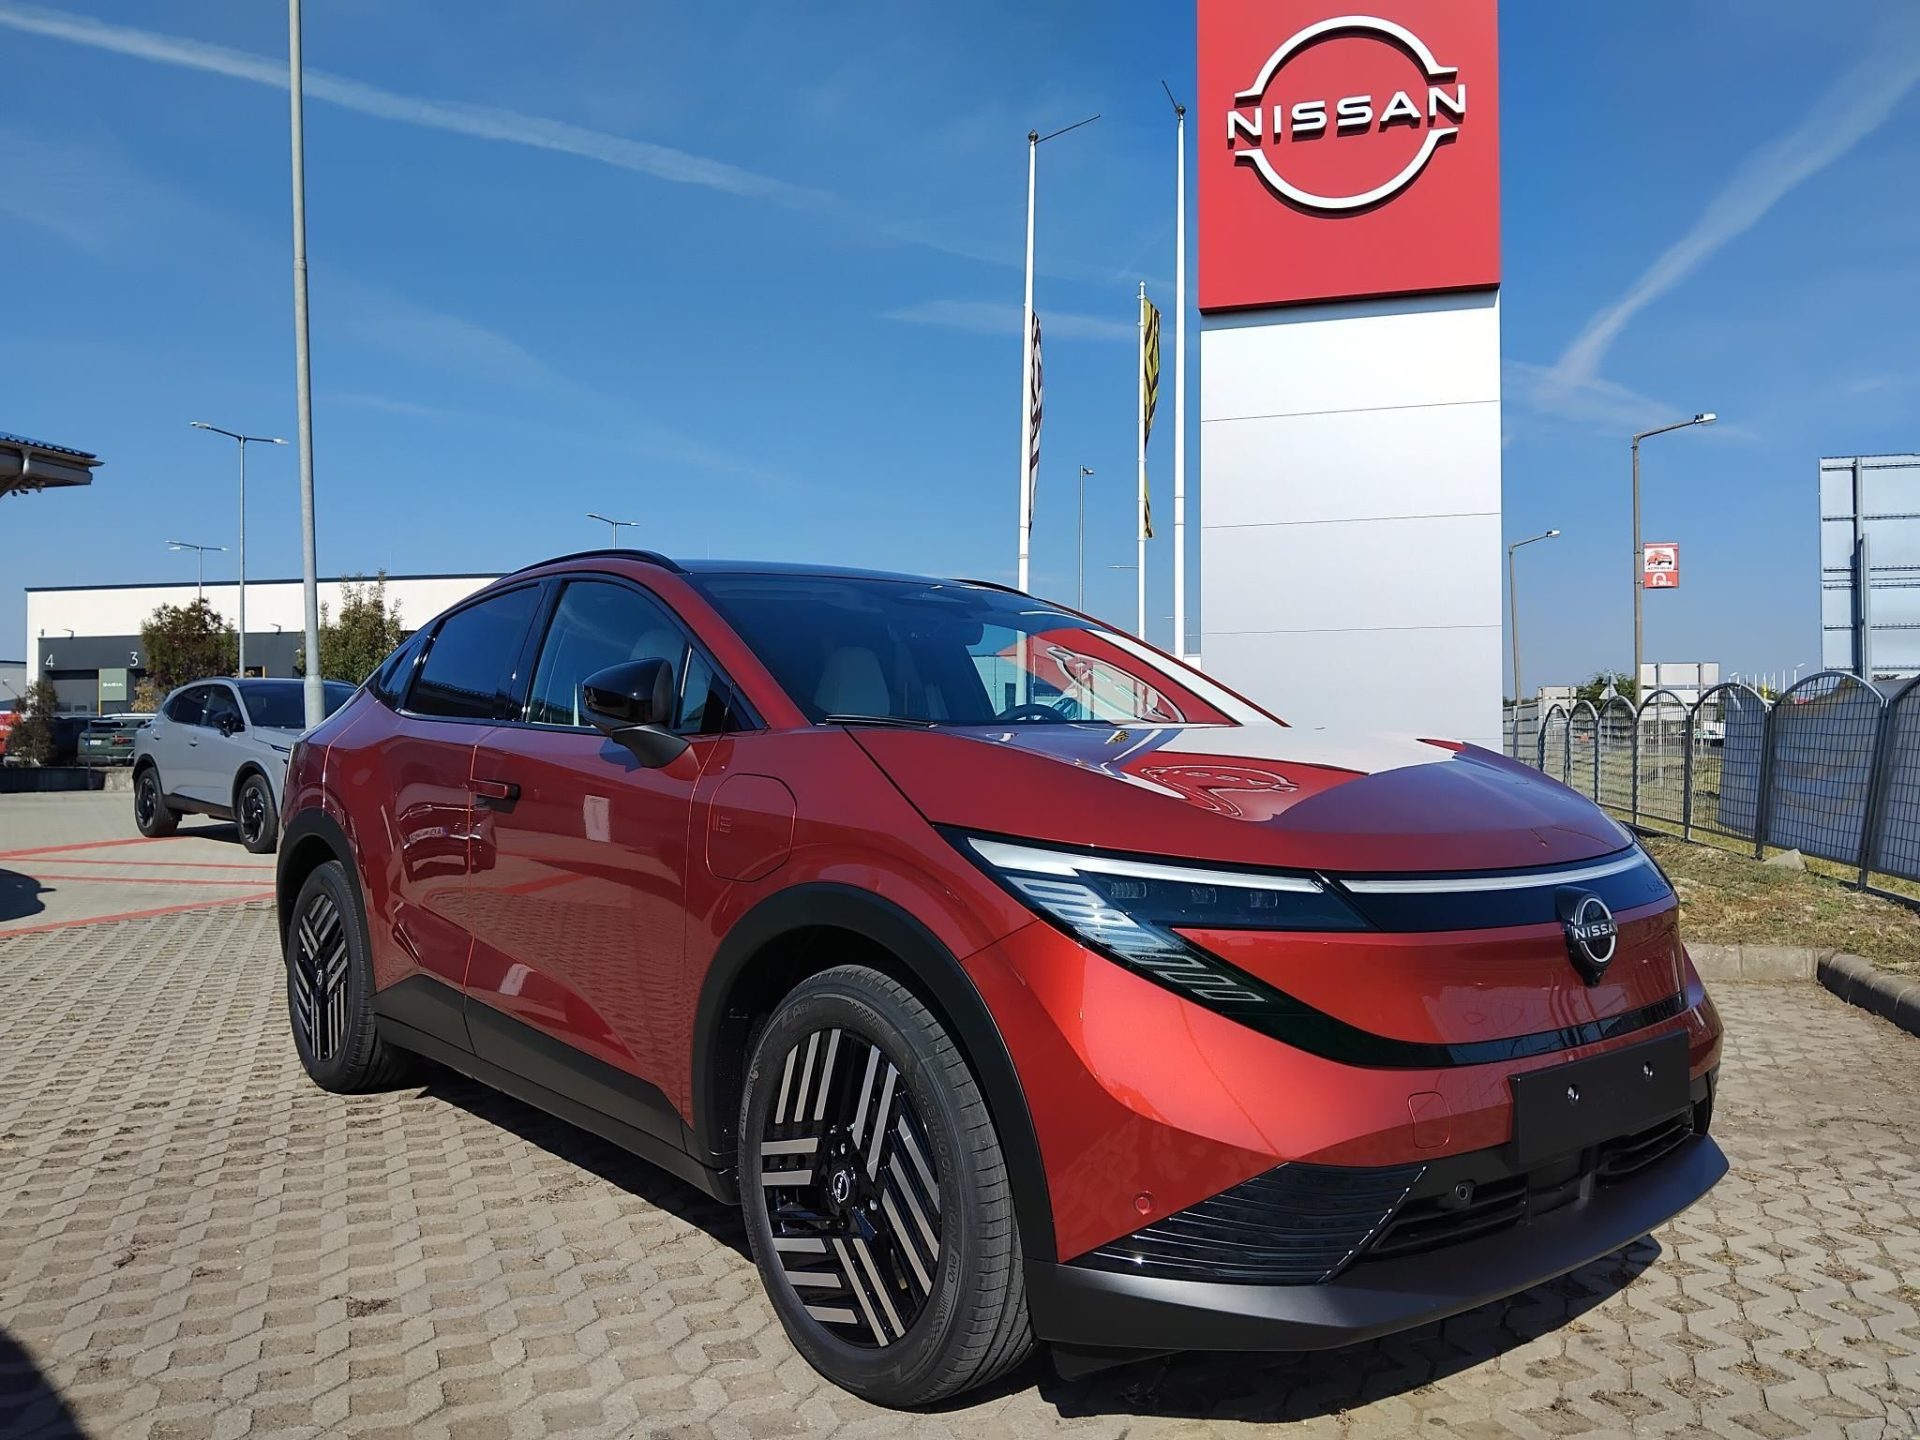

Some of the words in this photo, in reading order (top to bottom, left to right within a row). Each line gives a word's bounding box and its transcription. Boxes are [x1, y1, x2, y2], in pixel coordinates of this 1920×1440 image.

[1227, 84, 1466, 140] NISSAN
[45, 653, 55, 668] 4
[129, 651, 139, 667] 3
